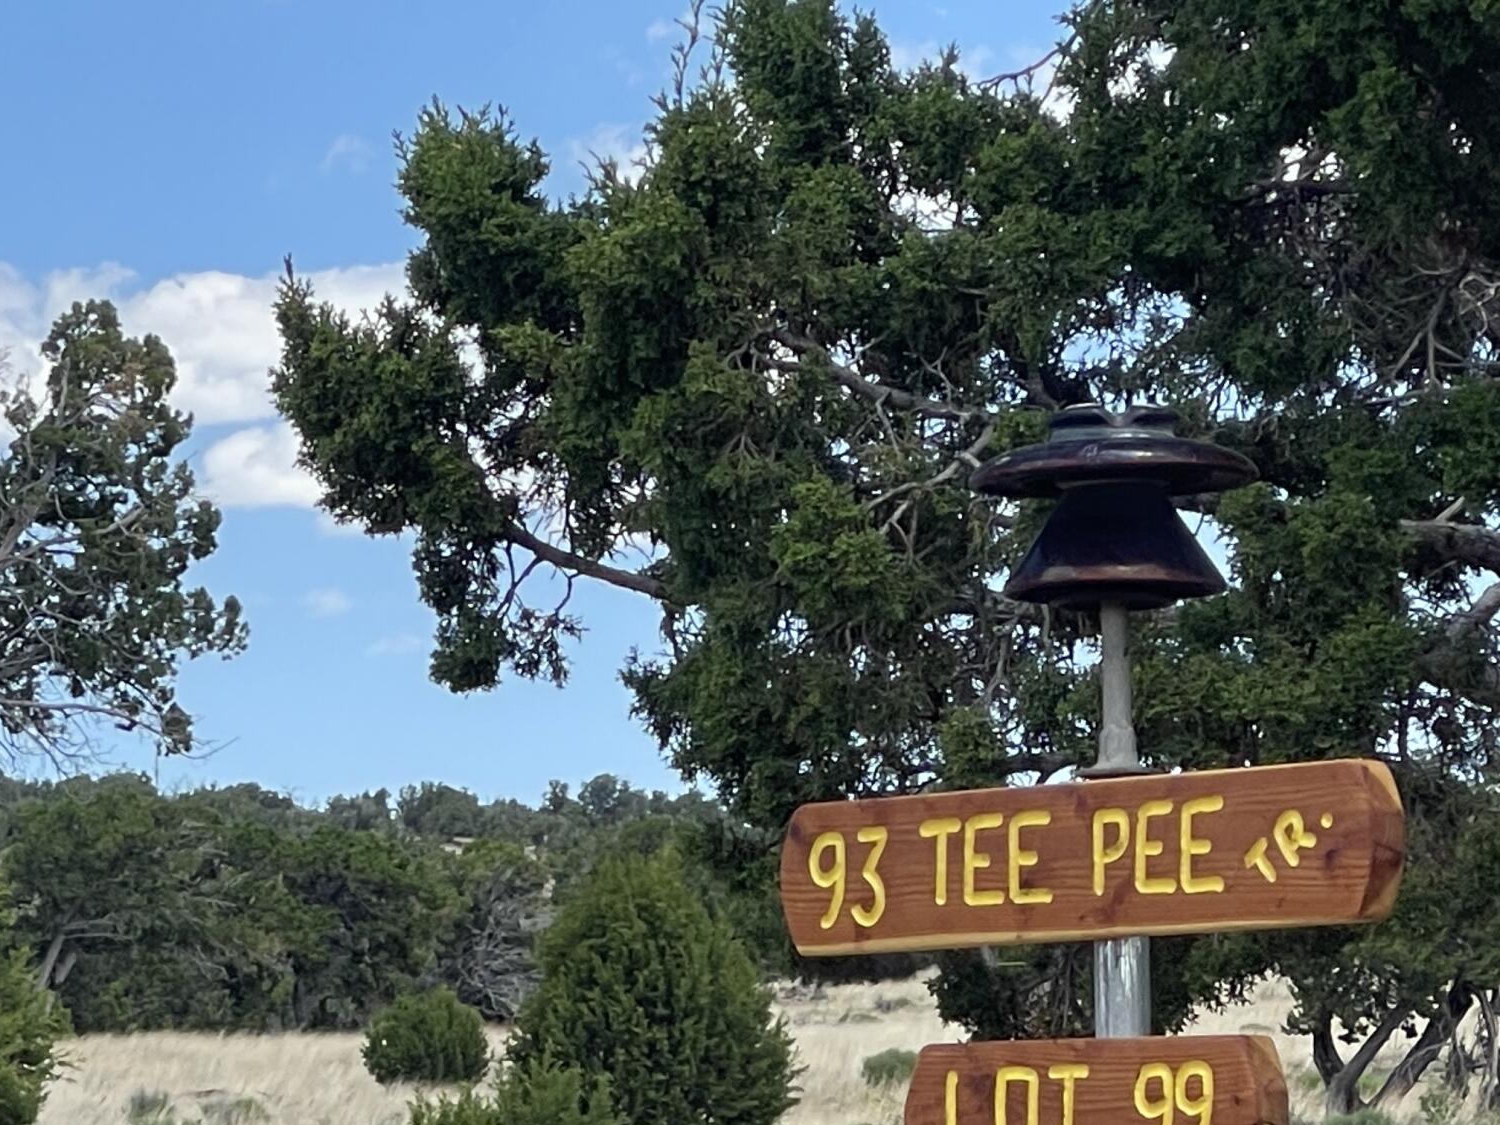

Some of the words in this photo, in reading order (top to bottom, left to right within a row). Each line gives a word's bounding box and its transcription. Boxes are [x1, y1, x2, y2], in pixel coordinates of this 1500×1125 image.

[808, 826, 888, 929] 93
[919, 810, 1054, 907] TEE
[1092, 796, 1226, 897] PEE
[1243, 810, 1335, 884] TR.
